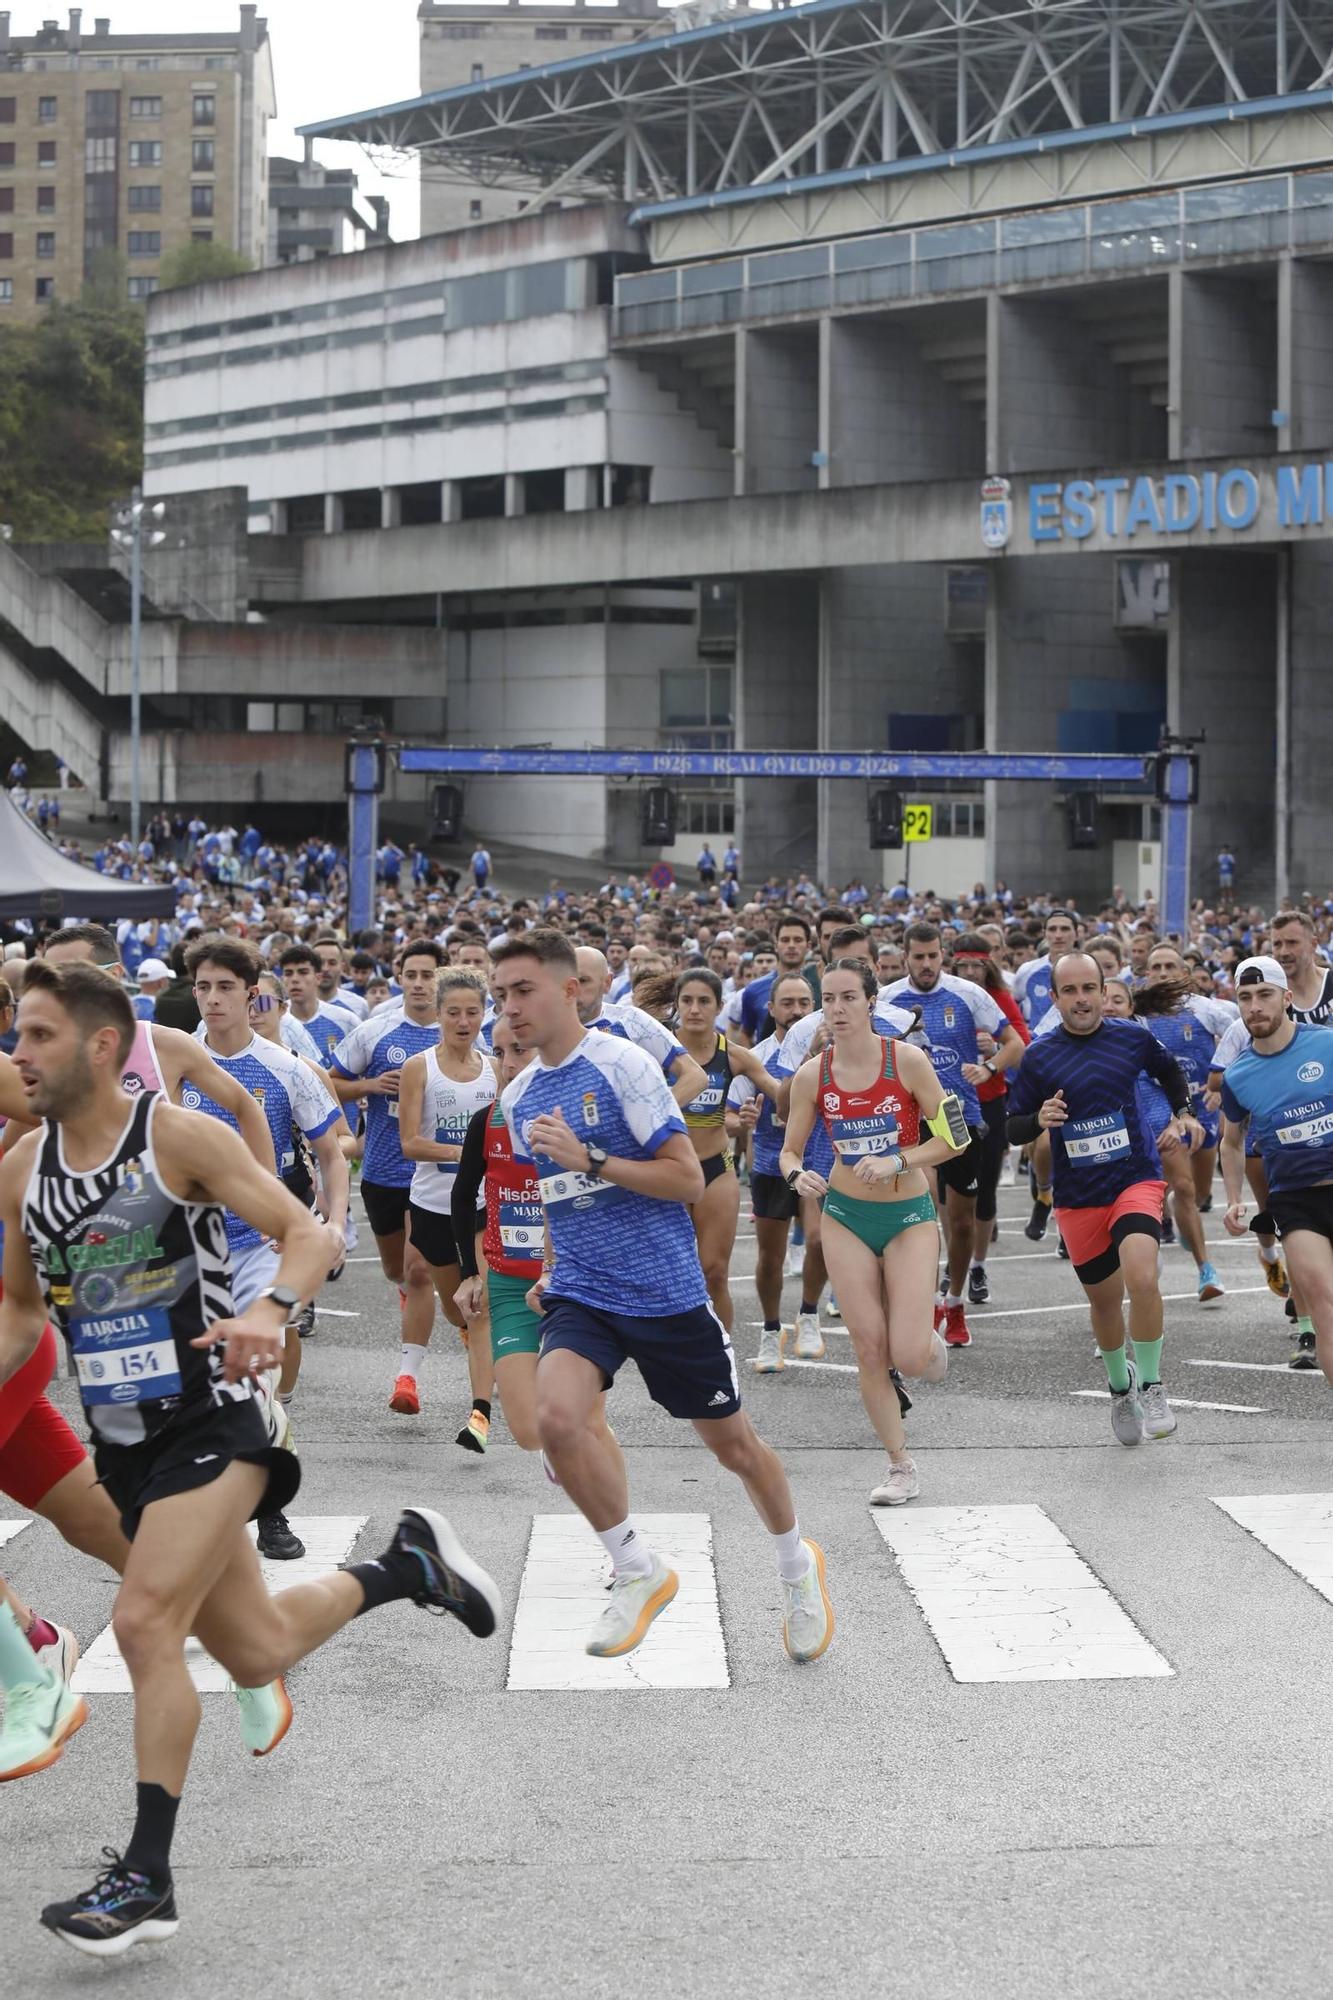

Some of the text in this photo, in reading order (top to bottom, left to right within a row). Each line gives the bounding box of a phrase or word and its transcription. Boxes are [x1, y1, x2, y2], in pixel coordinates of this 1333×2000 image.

[1029, 463, 1333, 541] ESTADIO M
[653, 755, 692, 772] 1926
[856, 756, 899, 774] 2026
[906, 811, 928, 834] P2
[873, 1103, 902, 1115] coa
[1283, 1101, 1325, 1119] MARCHA
[843, 1117, 886, 1131] MARCHA
[1073, 1116, 1115, 1131] MARCHA
[1307, 1117, 1333, 1136] 246
[868, 1136, 890, 1152] 124
[1098, 1134, 1122, 1150] 416
[80, 1313, 150, 1338] MARCHA
[120, 1350, 159, 1377] 154
